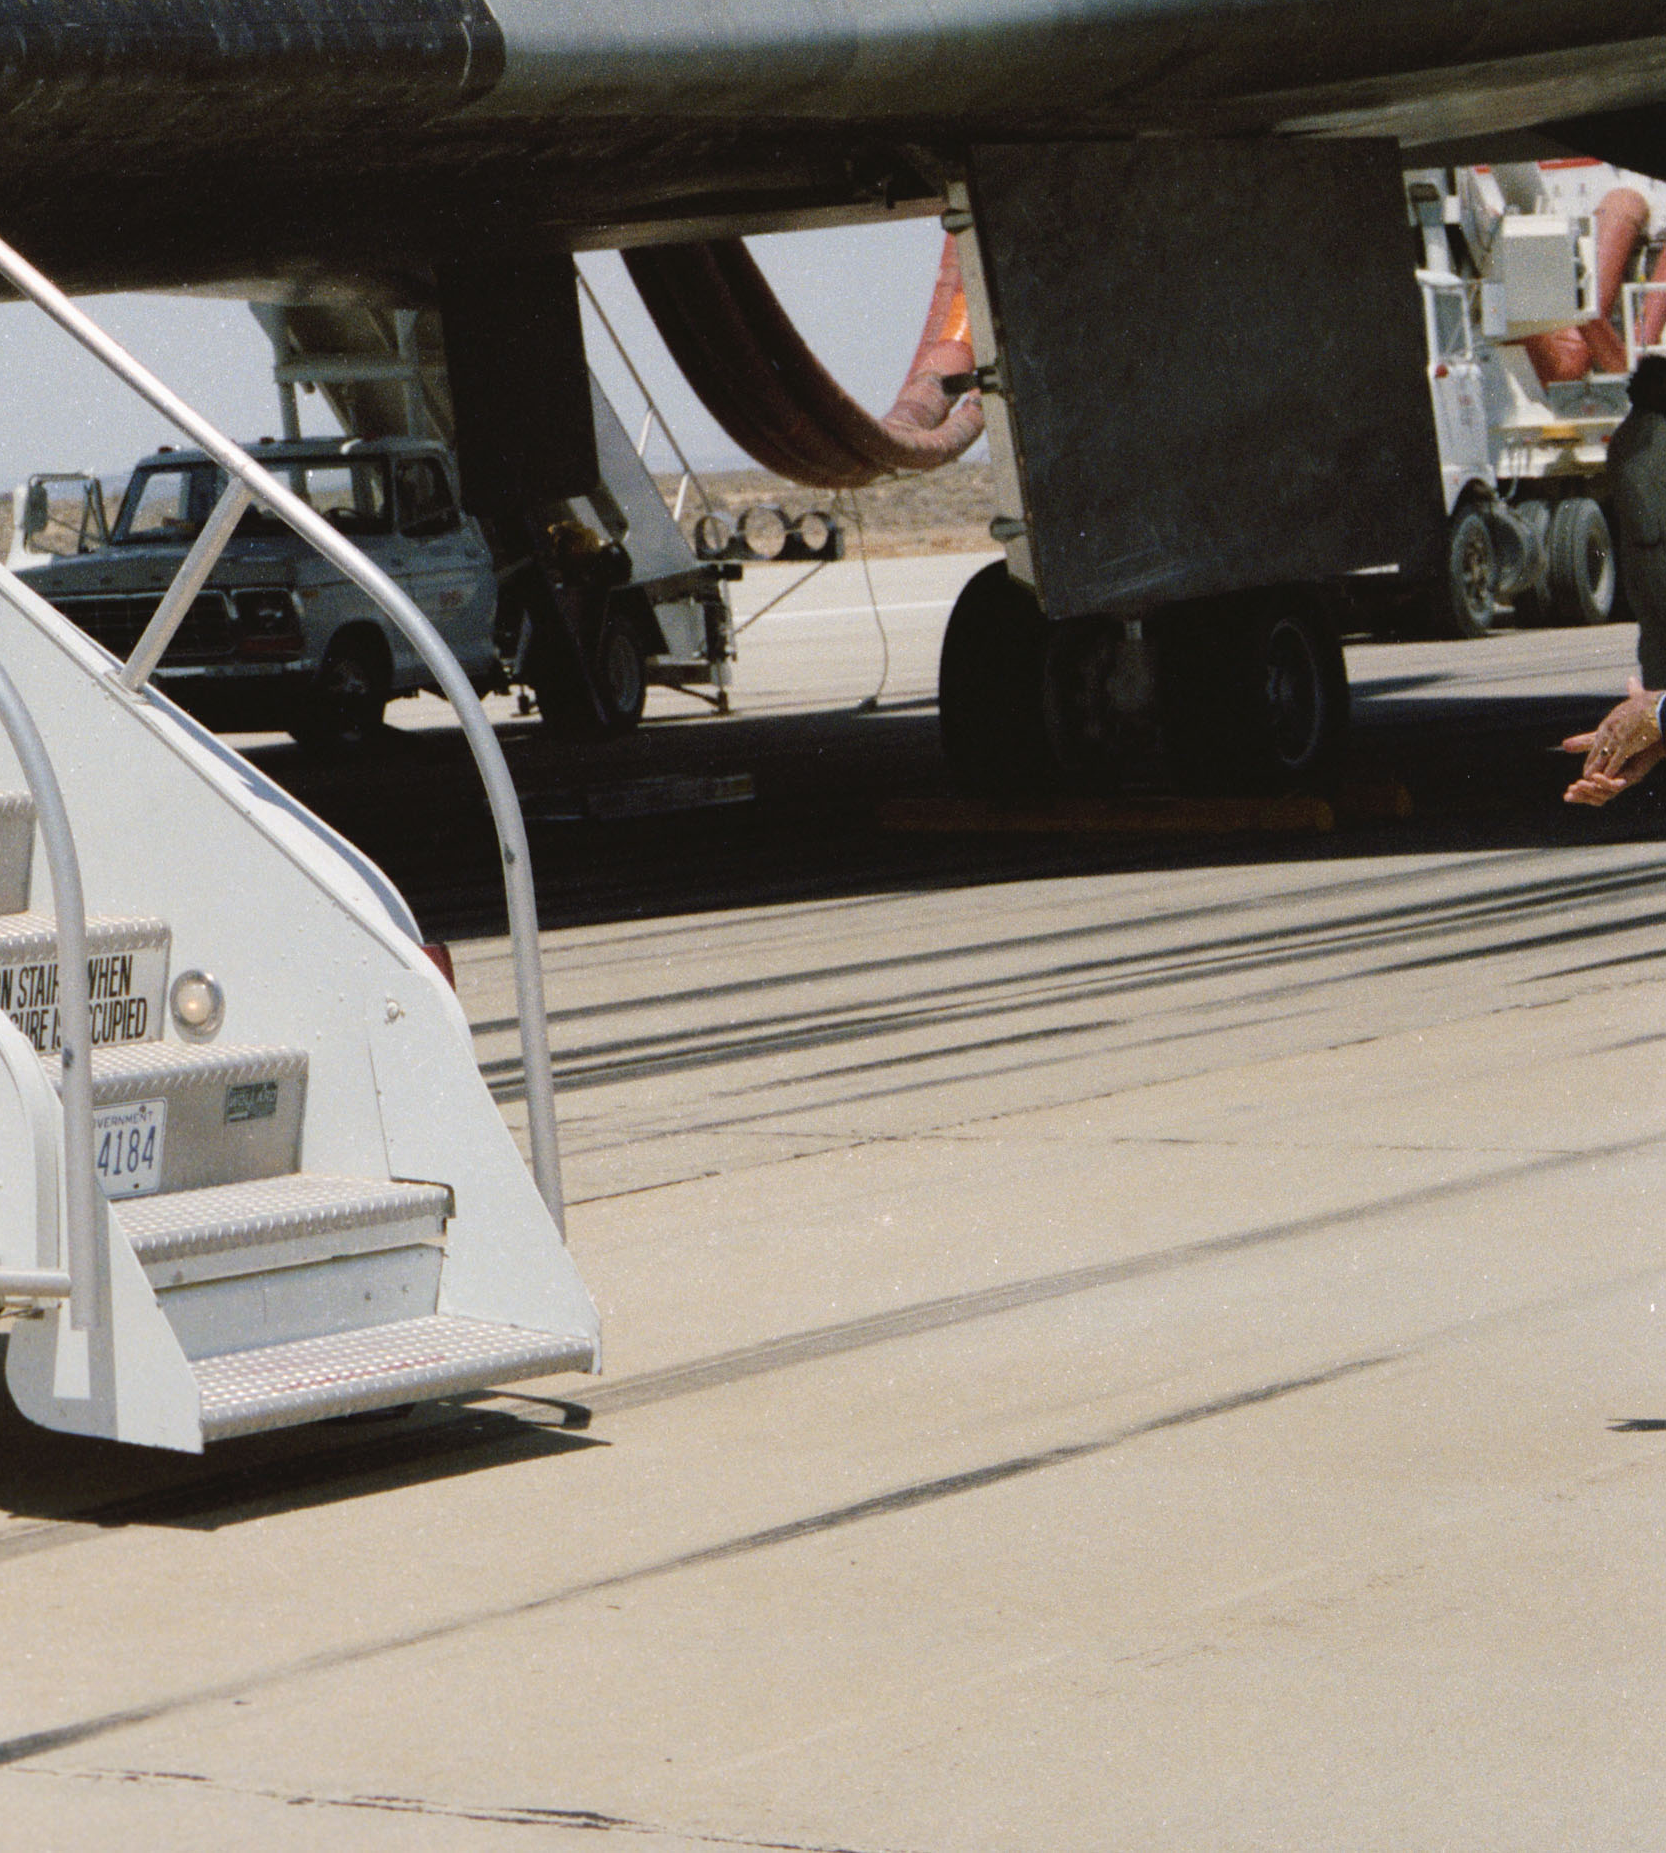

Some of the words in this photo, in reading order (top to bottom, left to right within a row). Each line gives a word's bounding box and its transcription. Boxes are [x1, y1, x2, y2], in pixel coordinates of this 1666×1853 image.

[89, 998, 147, 1045] CUPIED
[93, 1110, 154, 1130] VERNMENT
[97, 1125, 156, 1176] 4184
